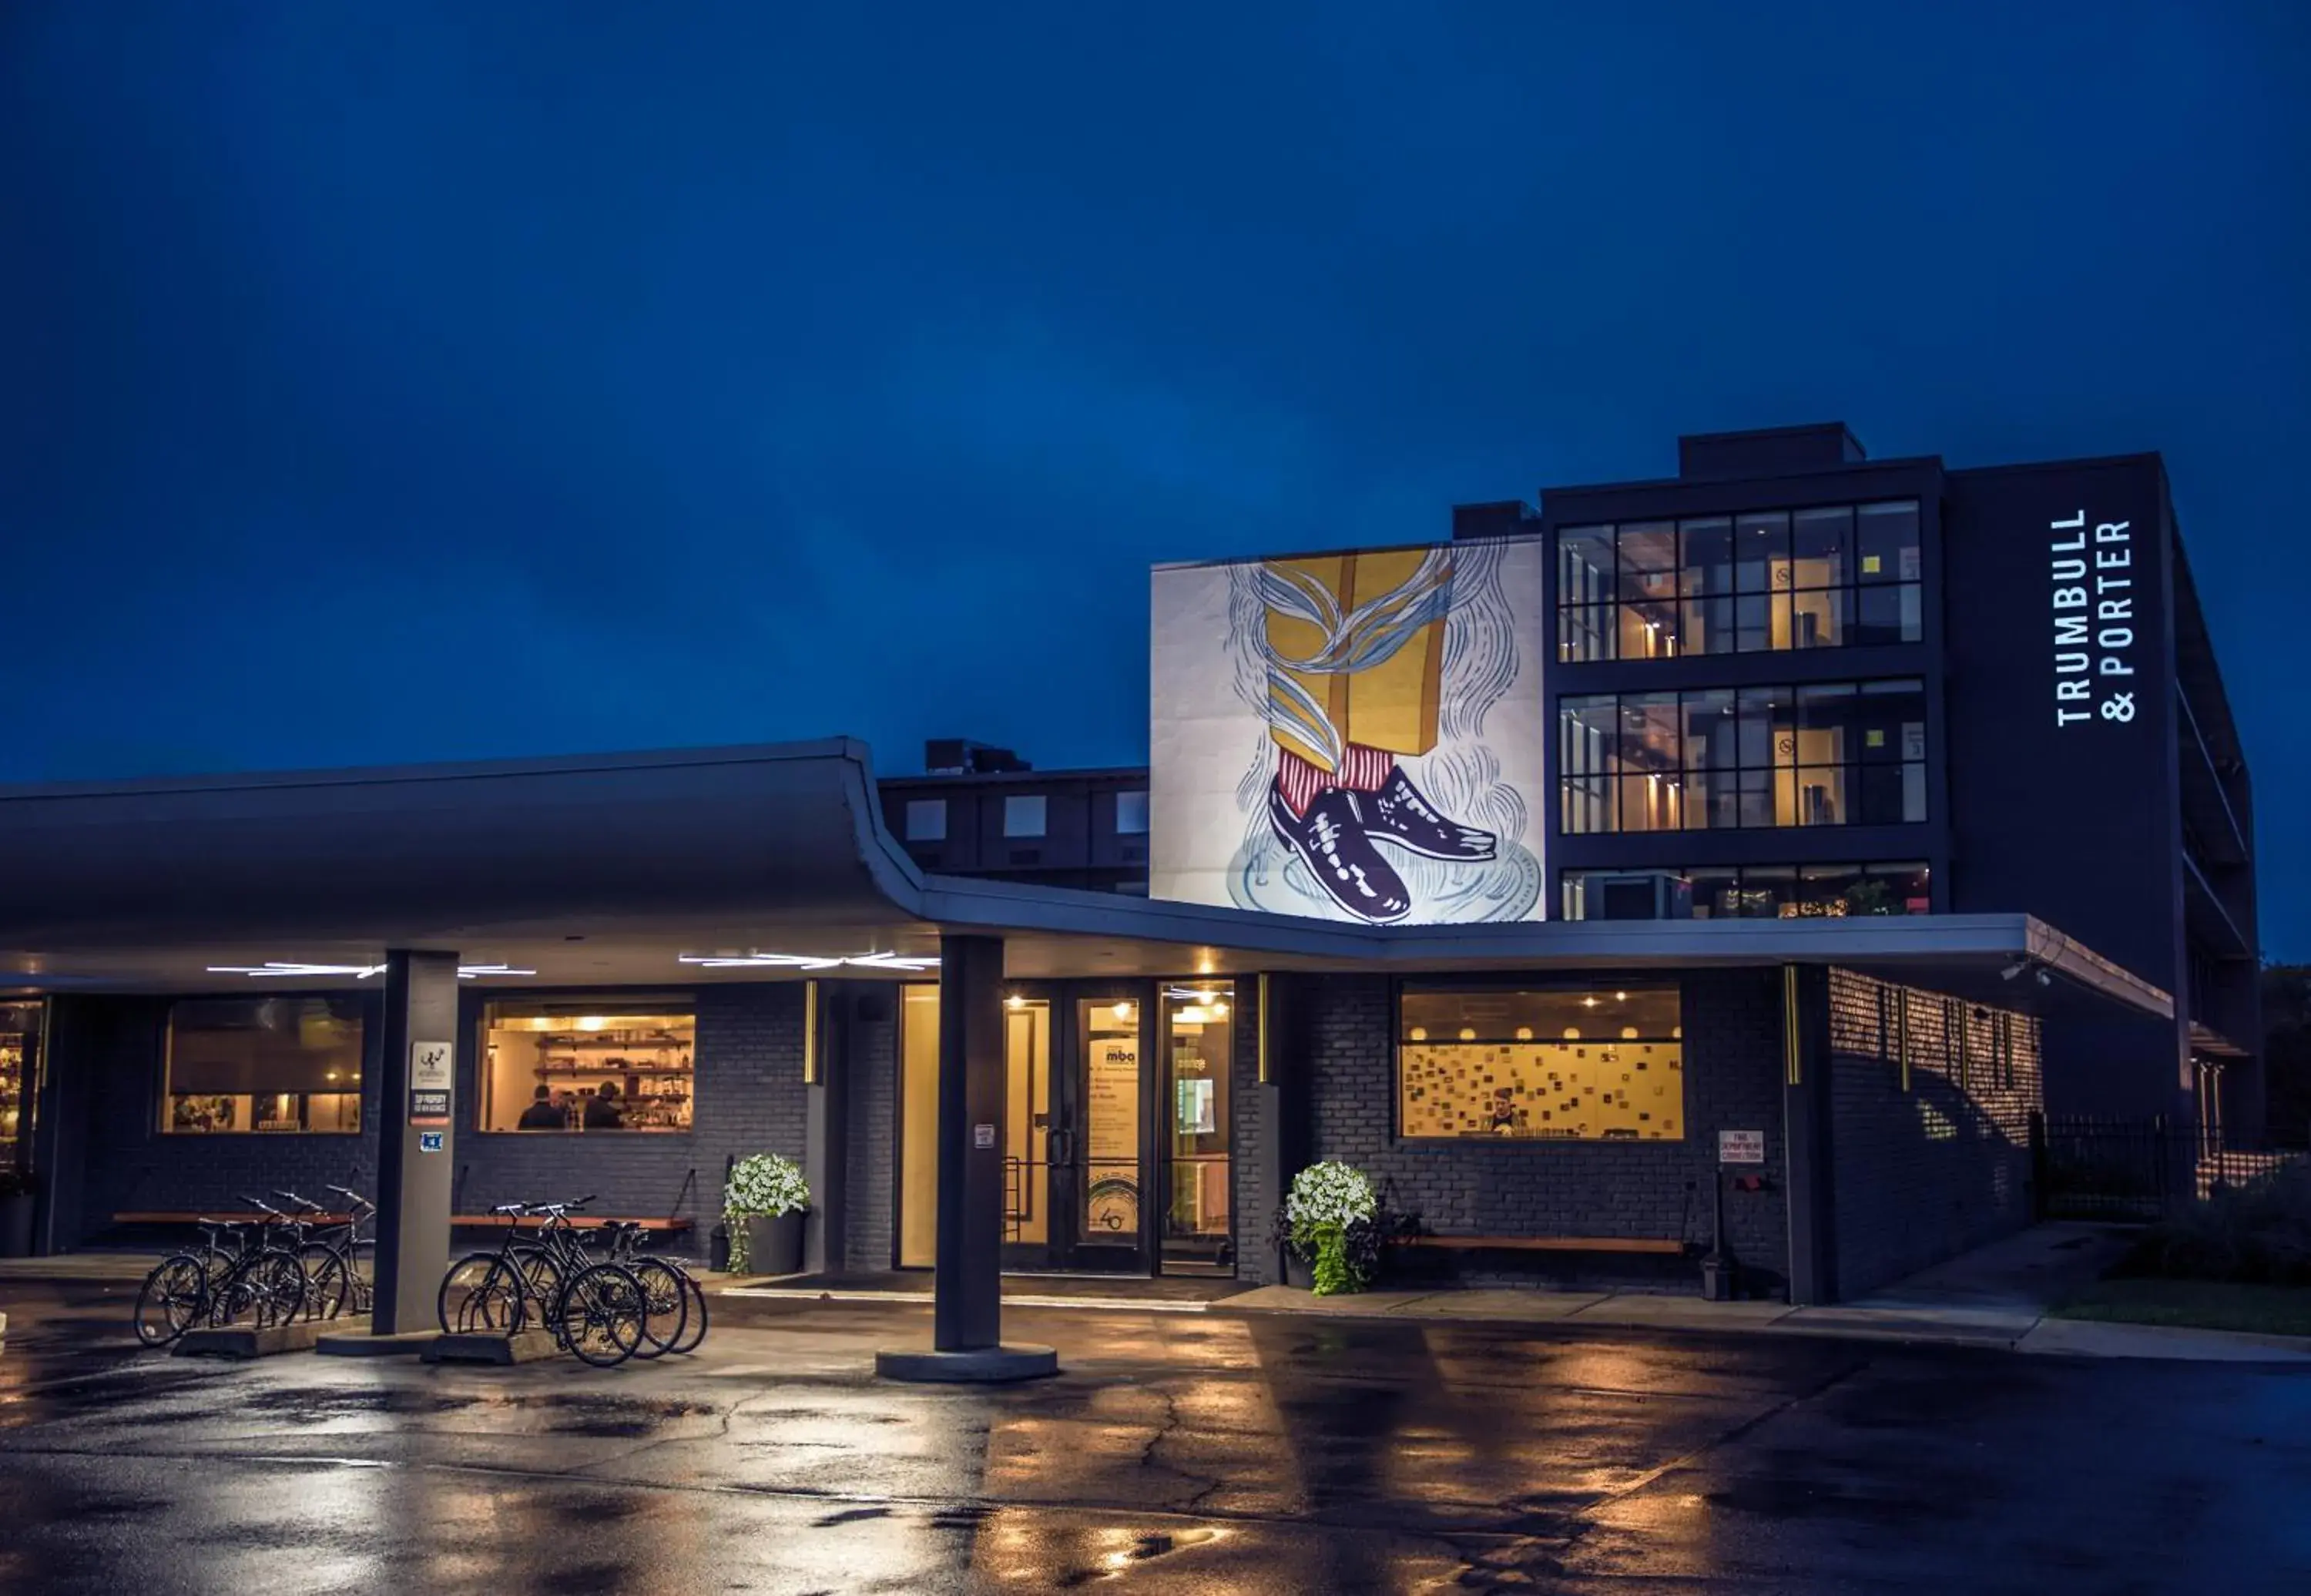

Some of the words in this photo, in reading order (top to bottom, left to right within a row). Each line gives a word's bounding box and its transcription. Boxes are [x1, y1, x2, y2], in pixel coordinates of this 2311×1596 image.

[2051, 509, 2091, 727] TRUMBULL
[2095, 521, 2134, 676] PORTER
[2101, 692, 2135, 723] &
[1106, 1050, 1135, 1061] mba
